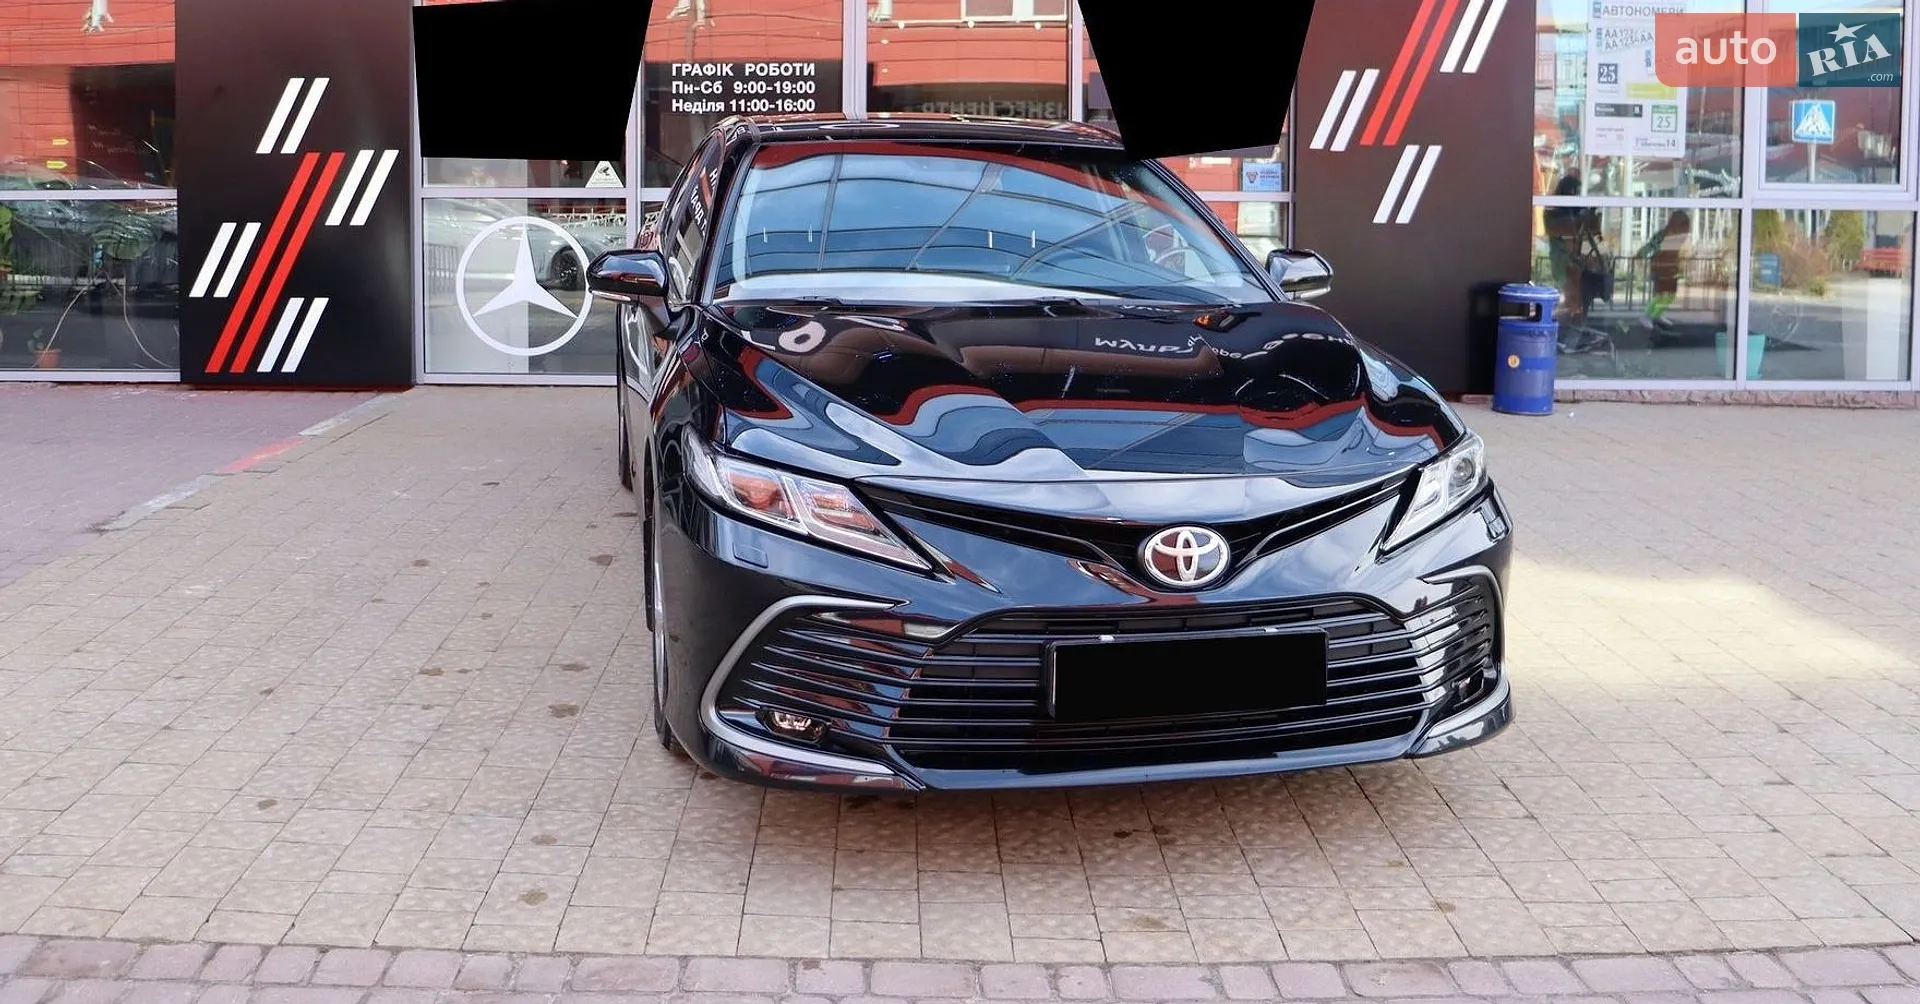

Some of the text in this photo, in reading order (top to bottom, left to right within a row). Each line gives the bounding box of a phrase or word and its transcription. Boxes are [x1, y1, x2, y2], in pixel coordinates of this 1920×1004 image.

[672, 63, 815, 76] ГРАФІК РОБОТИ
[1600, 65, 1616, 82] 25
[672, 81, 816, 94] Пн-Сб 9:00-19:00
[672, 99, 816, 114] Неділя 11:00-16:00
[1657, 115, 1672, 128] 25
